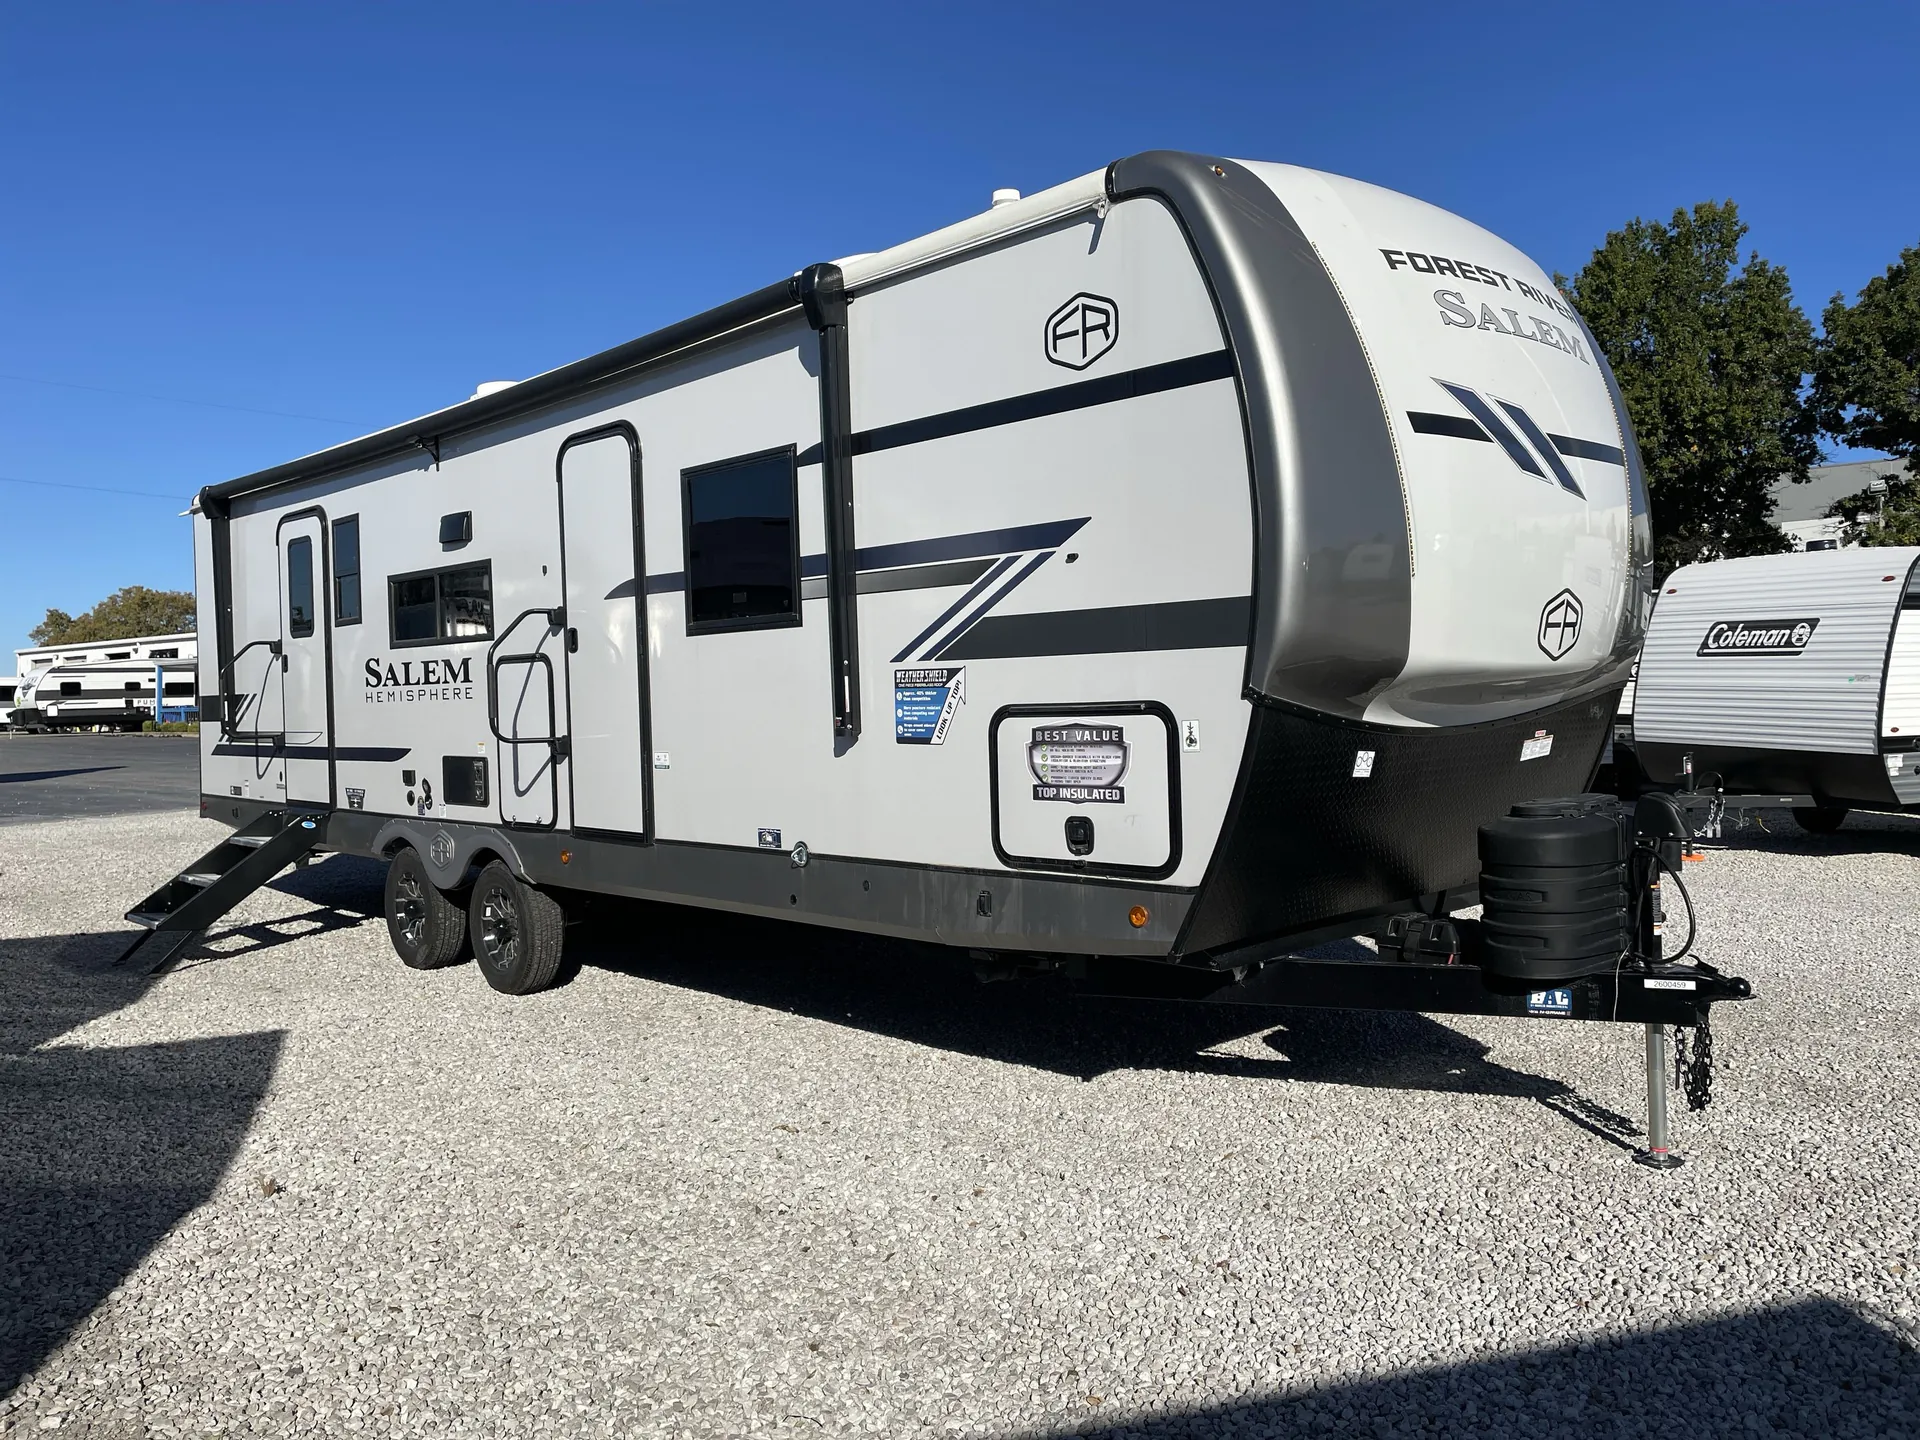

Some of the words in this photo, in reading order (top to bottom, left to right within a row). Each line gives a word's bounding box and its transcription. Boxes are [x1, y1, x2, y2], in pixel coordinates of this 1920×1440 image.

[1378, 248, 1512, 291] FOREST
[1512, 277, 1580, 329] RIVER
[1433, 289, 1590, 365] SALEM
[1707, 623, 1791, 648] Coleman
[365, 657, 473, 688] SALEM
[365, 687, 473, 703] HEMISPHERE
[936, 717, 948, 740] LOOK
[945, 701, 953, 715] UP
[951, 679, 962, 700] TOP!
[1035, 730, 1068, 741] BEST
[1075, 730, 1119, 741] VALUE
[1036, 787, 1057, 798] TOP
[1060, 788, 1120, 800] INSULATED
[1653, 980, 1687, 989] 2600459
